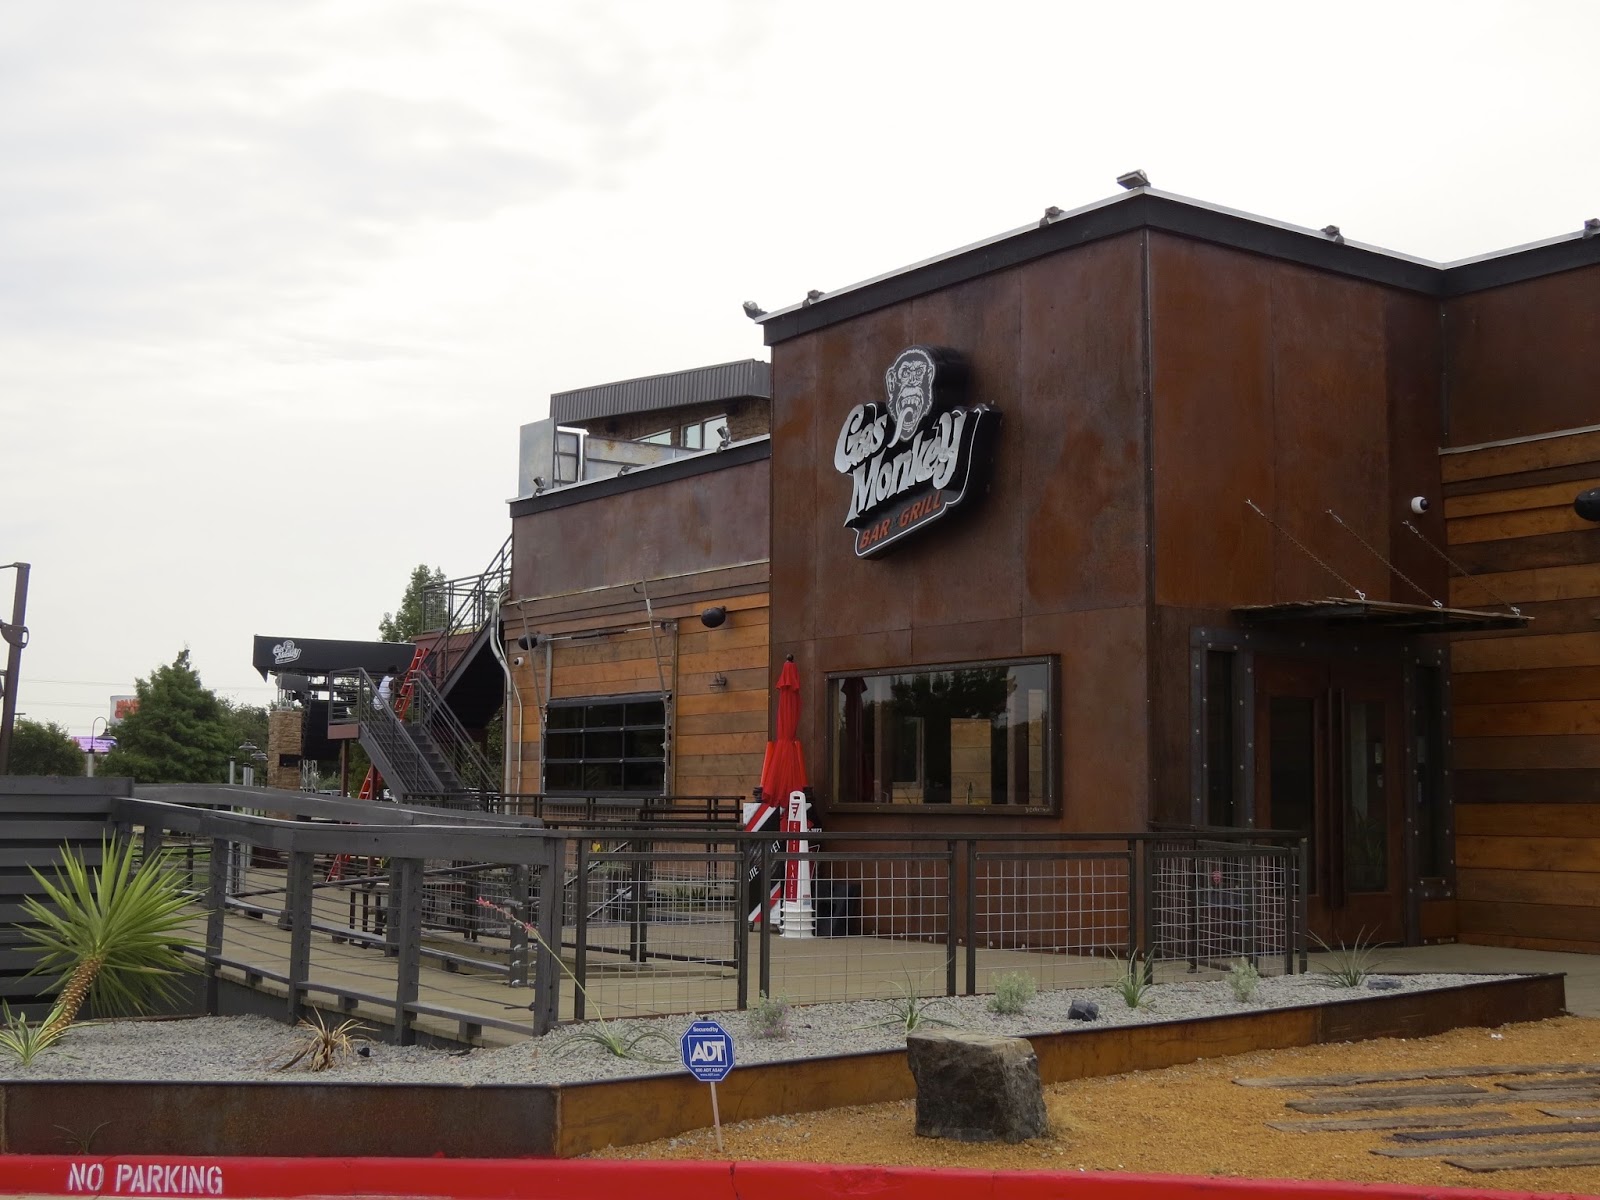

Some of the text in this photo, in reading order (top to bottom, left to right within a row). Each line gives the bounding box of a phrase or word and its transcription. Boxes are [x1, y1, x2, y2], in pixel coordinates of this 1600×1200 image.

[834, 404, 888, 473] Gas
[843, 411, 967, 527] Monkey
[860, 490, 942, 549] BAR GRILL
[691, 1040, 725, 1062] ADT
[69, 1163, 223, 1195] NO PARKING
